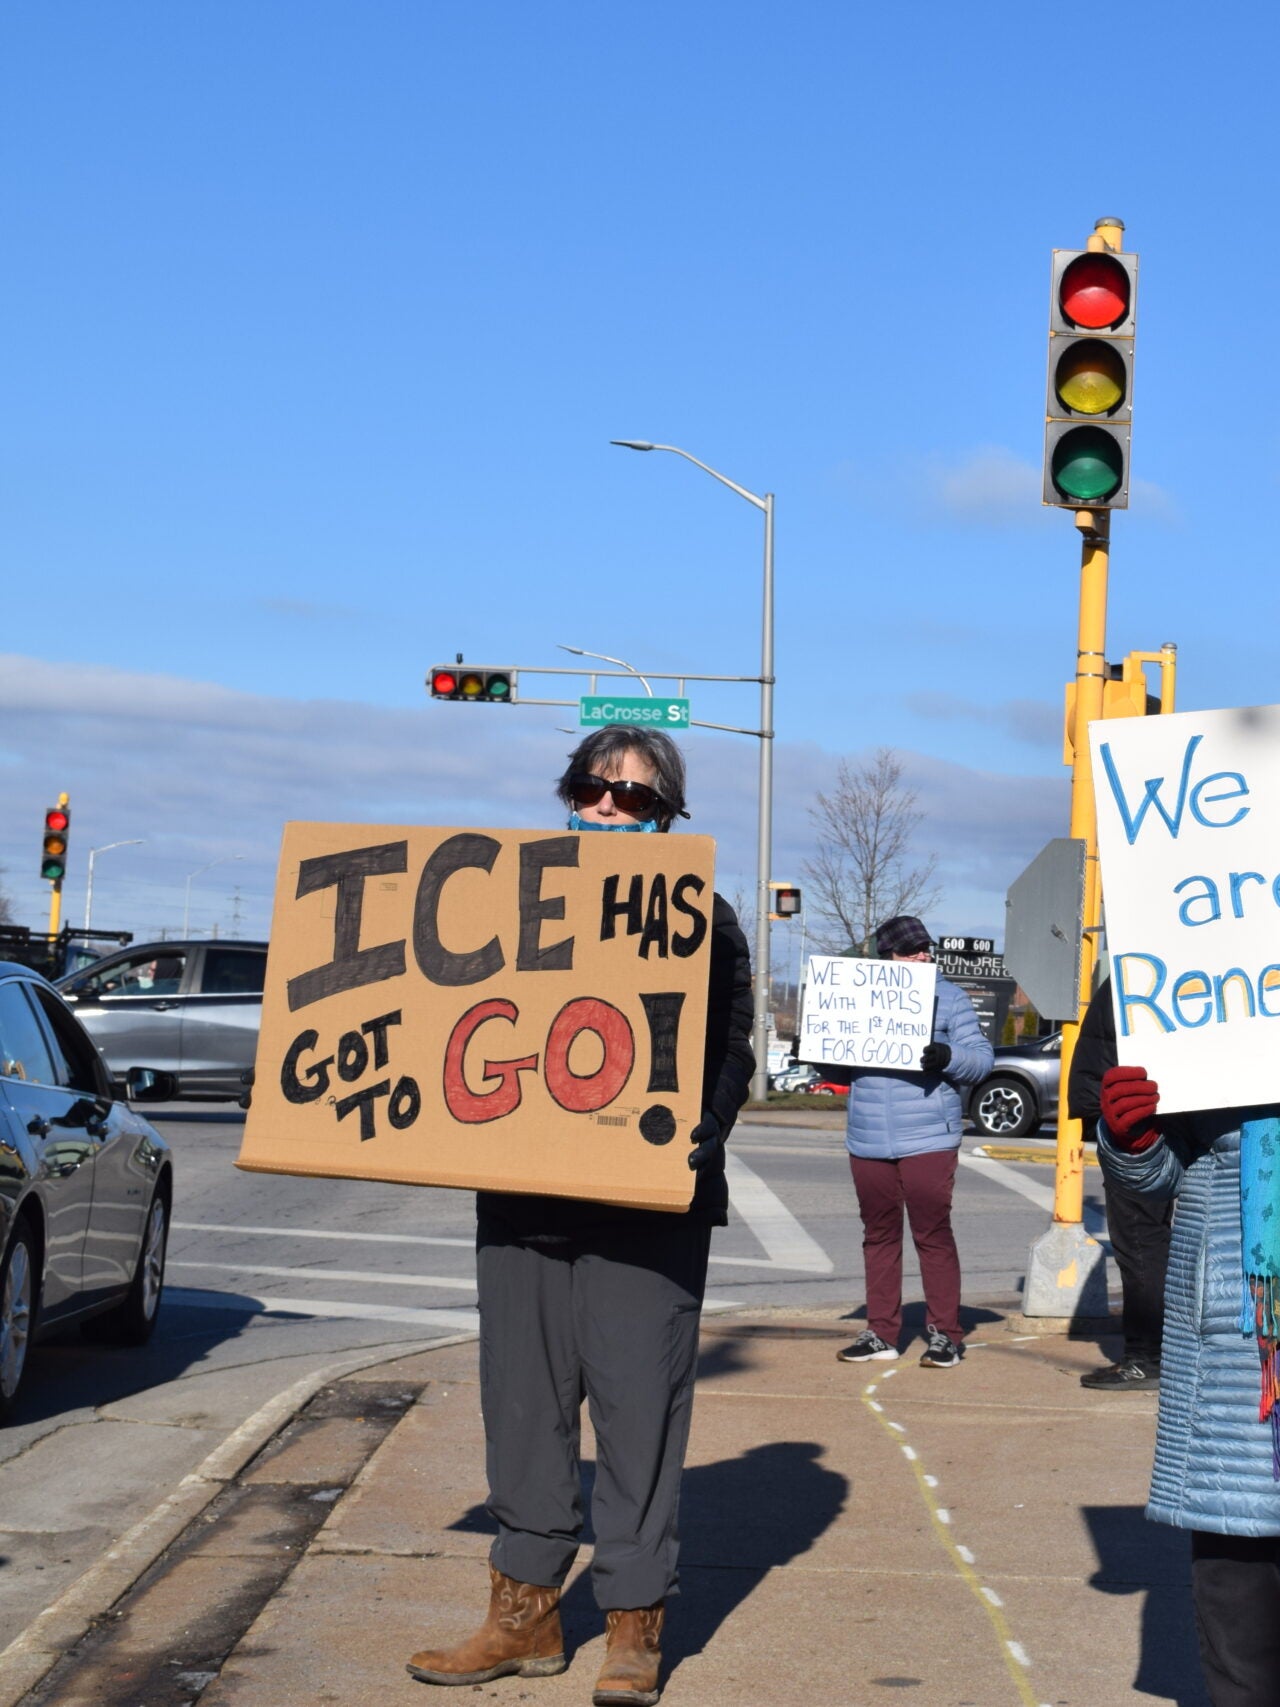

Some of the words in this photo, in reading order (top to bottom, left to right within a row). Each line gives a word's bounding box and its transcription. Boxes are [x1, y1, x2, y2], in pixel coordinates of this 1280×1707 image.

[581, 703, 662, 721] LaCrosse
[667, 704, 690, 722] St
[1100, 734, 1250, 845] We
[287, 832, 580, 1012] ICE
[600, 873, 707, 958] HAS
[943, 938, 965, 950] 600
[973, 939, 991, 952] 600
[810, 958, 844, 986] WE
[853, 962, 913, 989] STAND
[936, 953, 1005, 970] HUNDRE
[819, 991, 857, 1011] WITH
[870, 989, 922, 1015] MPLS
[837, 1020, 861, 1035] THE
[885, 1017, 928, 1037] AMEND
[281, 1010, 402, 1104] GOT
[822, 1038, 857, 1063] FOR
[862, 1037, 913, 1065] GOOD
[442, 991, 686, 1146] GO!
[336, 1075, 421, 1141] TO
